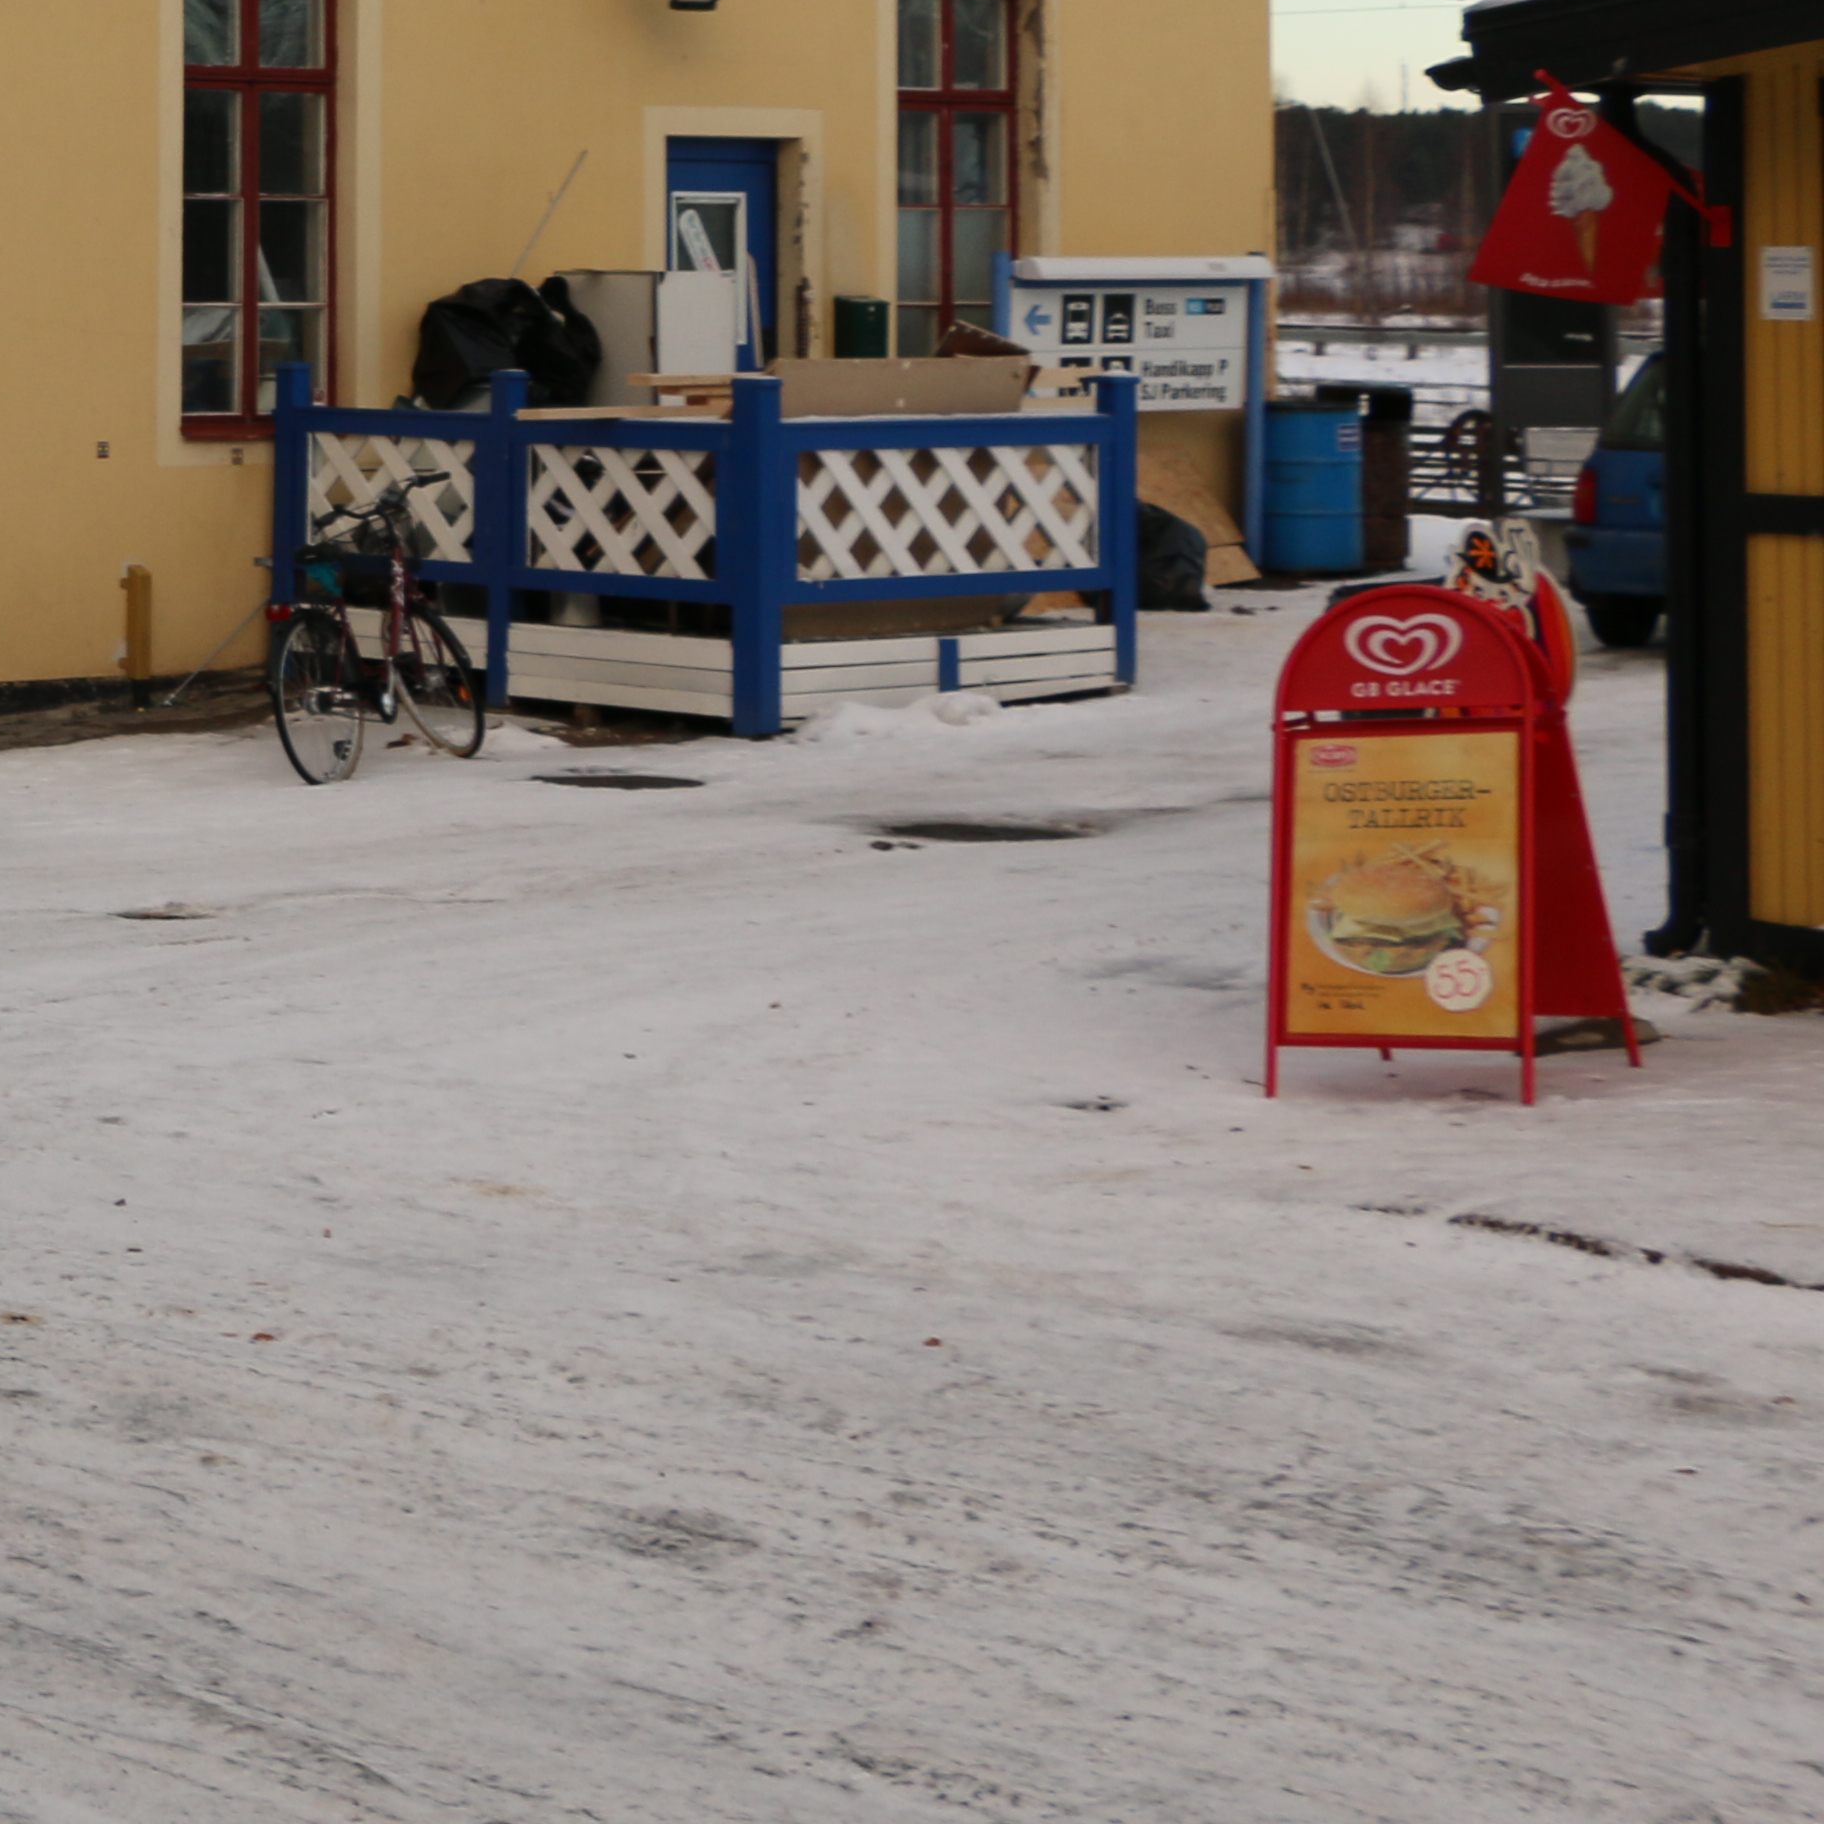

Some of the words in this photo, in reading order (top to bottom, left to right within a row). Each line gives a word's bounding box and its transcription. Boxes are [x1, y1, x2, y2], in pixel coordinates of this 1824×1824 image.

[1144, 321, 1175, 339] Taxi
[1142, 359, 1215, 379] Handikapp
[1160, 382, 1228, 403] Parkering
[1350, 681, 1381, 698] GB
[1385, 678, 1457, 696] GLACE
[1323, 779, 1493, 803] OSTBURGER-
[1347, 807, 1468, 830] TALLRIK
